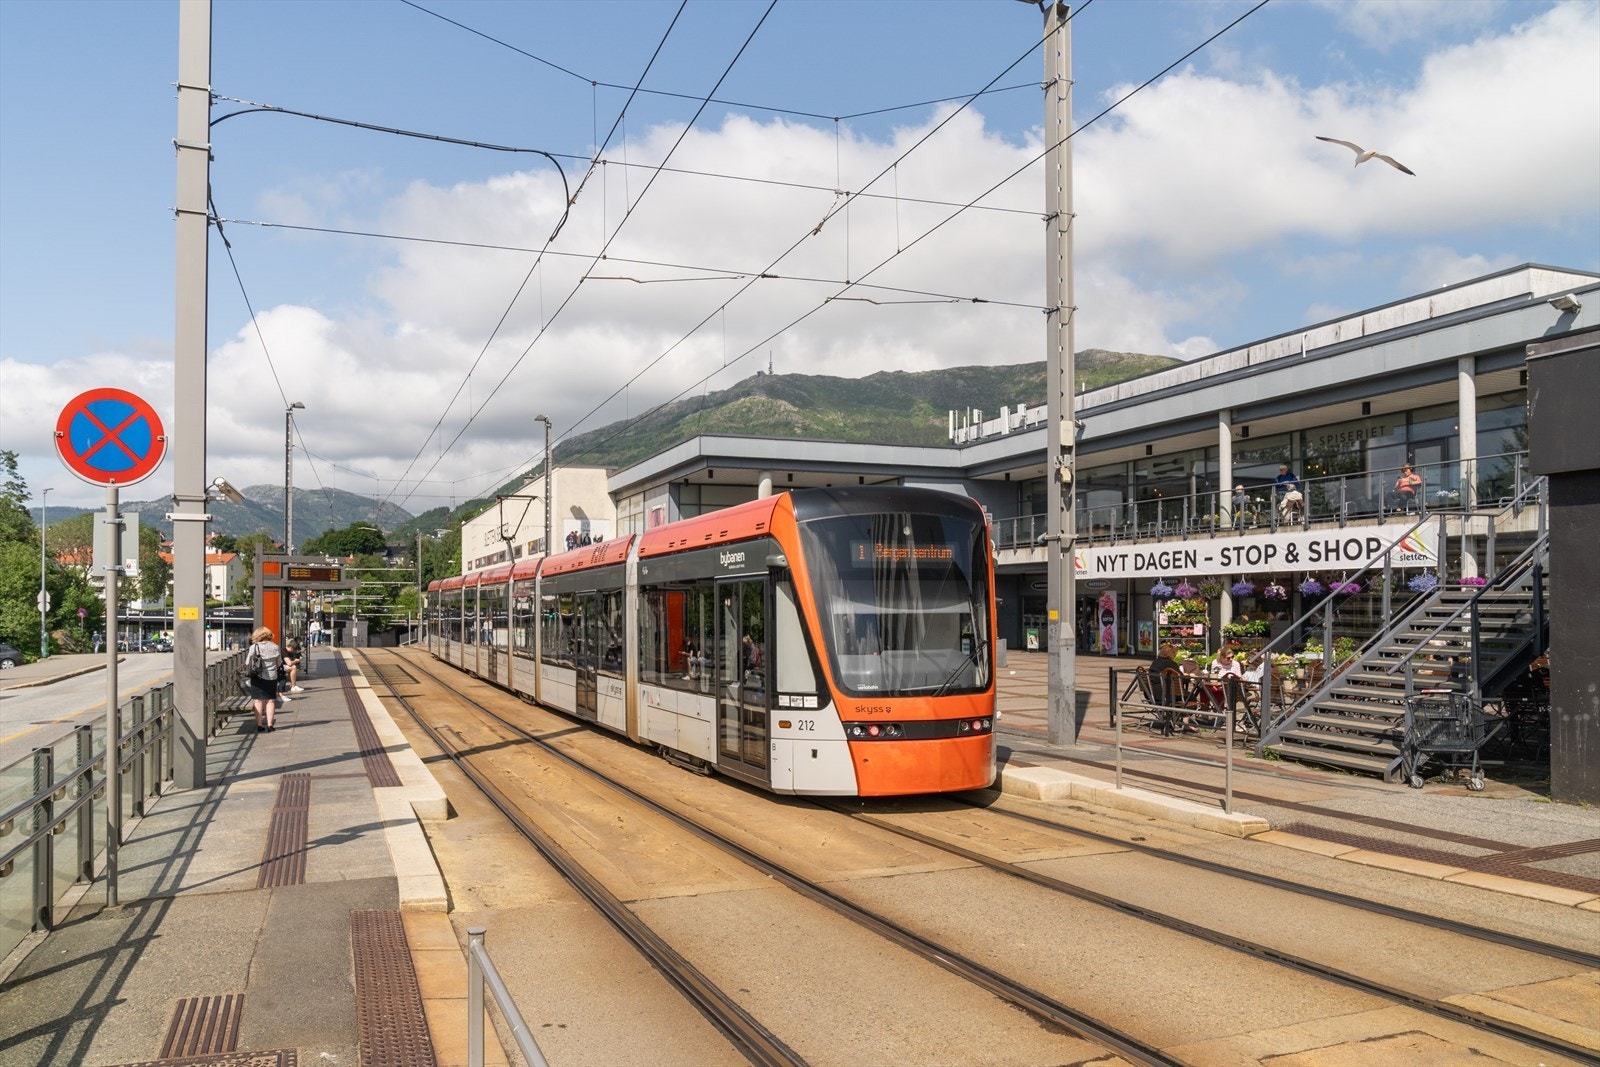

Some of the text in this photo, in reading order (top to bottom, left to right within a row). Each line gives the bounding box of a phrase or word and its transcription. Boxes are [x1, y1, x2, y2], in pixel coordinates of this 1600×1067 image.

[1319, 425, 1385, 446] SPISERIET
[720, 551, 745, 567] bybanen
[859, 543, 952, 561] 1 Bergen sentrum
[1096, 554, 1129, 573] NYT
[1134, 549, 1197, 571] DAGEN
[1220, 543, 1277, 567] STOP
[1285, 542, 1300, 564] &
[1308, 537, 1382, 562] SHOP
[1399, 553, 1428, 562] sletten
[855, 705, 884, 714] skyss
[798, 720, 815, 731] 212
